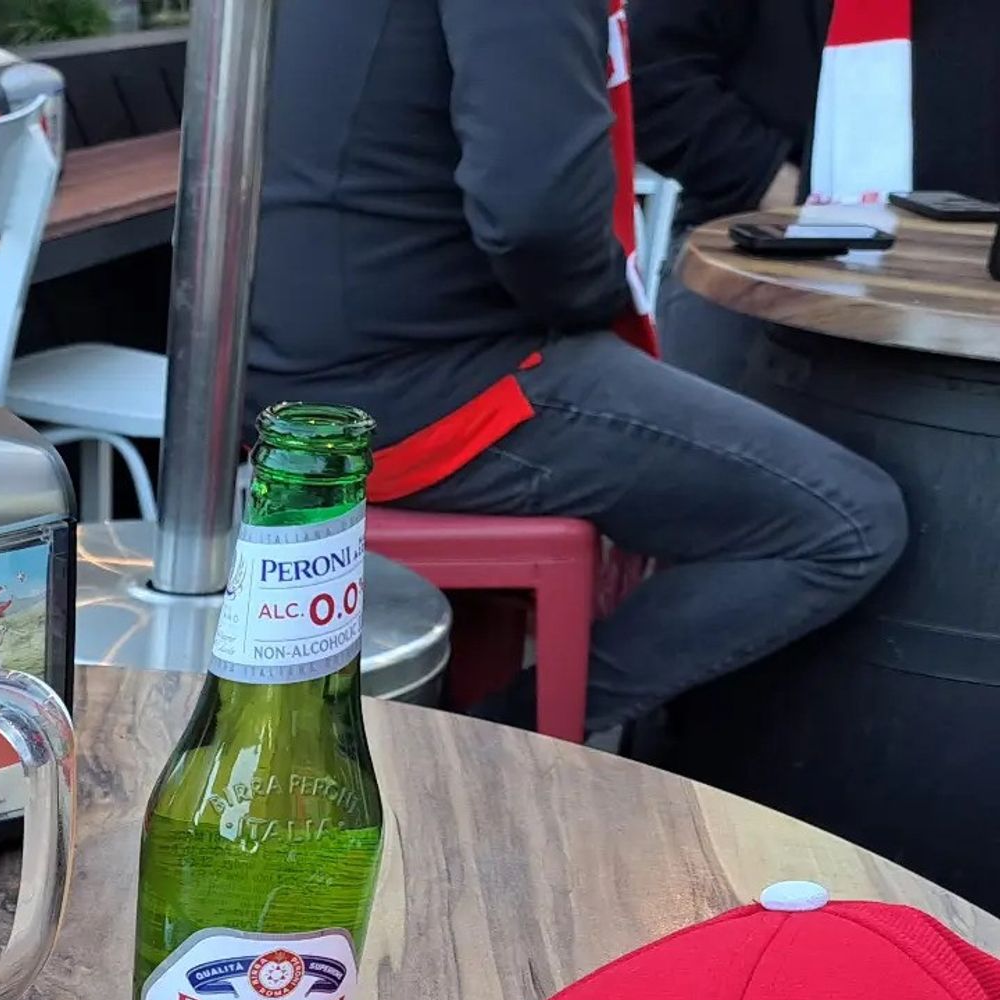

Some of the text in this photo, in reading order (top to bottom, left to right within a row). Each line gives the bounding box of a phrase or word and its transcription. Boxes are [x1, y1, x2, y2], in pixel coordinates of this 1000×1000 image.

[259, 545, 352, 582] PERONI
[257, 602, 305, 620] ALC.
[253, 622, 357, 660] NON-ALCOHOLIC
